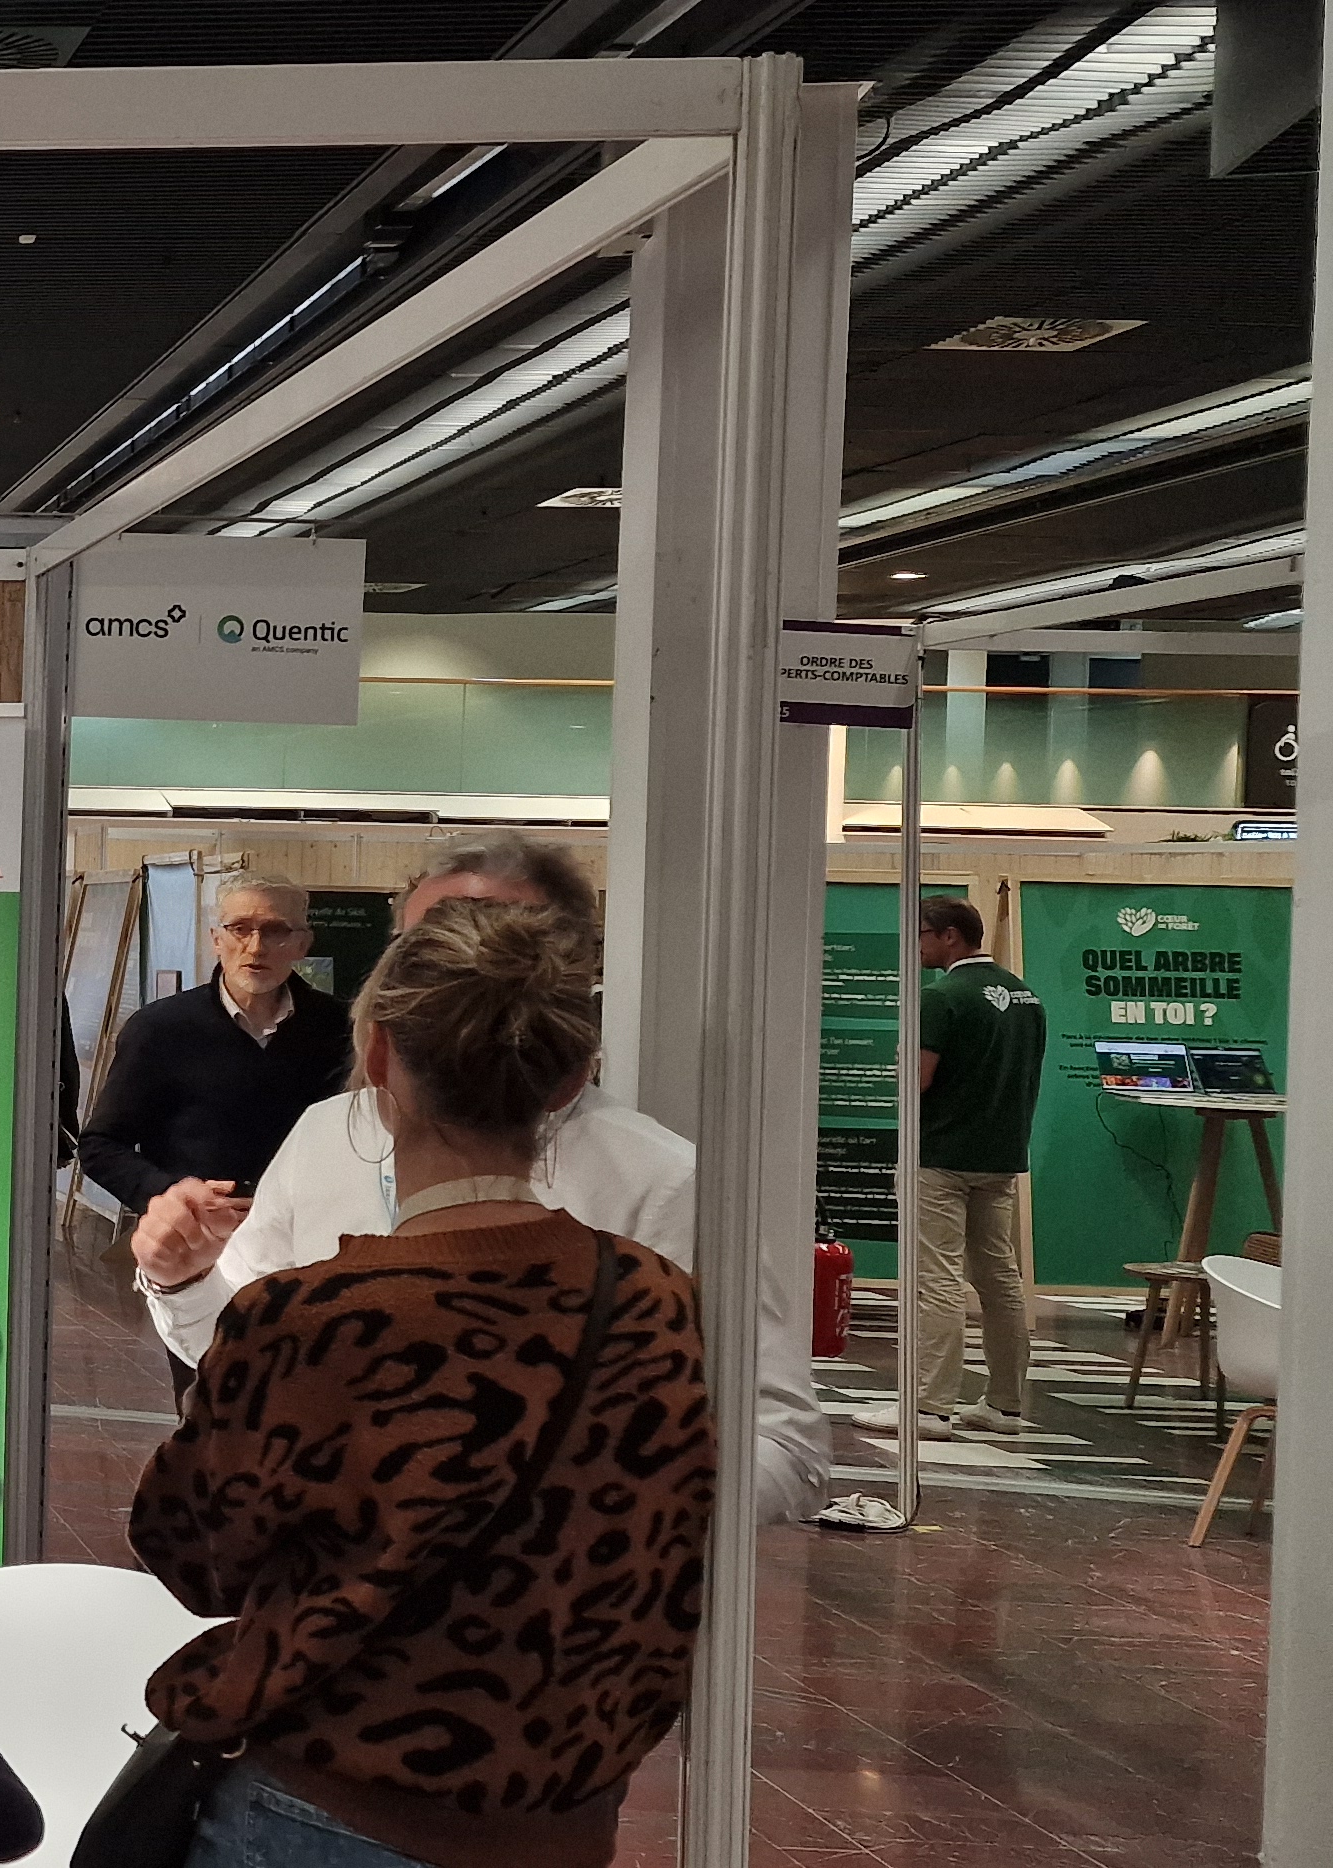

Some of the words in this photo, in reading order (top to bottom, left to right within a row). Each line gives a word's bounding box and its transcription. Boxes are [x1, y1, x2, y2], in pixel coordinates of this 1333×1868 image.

[85, 616, 169, 638] amcs
[252, 619, 349, 643] Quentic
[800, 655, 846, 669] ORDRE
[849, 658, 874, 670] DES
[1082, 949, 1149, 972] QUEL
[1154, 950, 1243, 973] ARBRE
[1085, 975, 1241, 1000] SOMMEILLE
[1111, 1001, 1146, 1024] EN
[1150, 1002, 1195, 1025] TOI
[1199, 1002, 1218, 1026] ?
